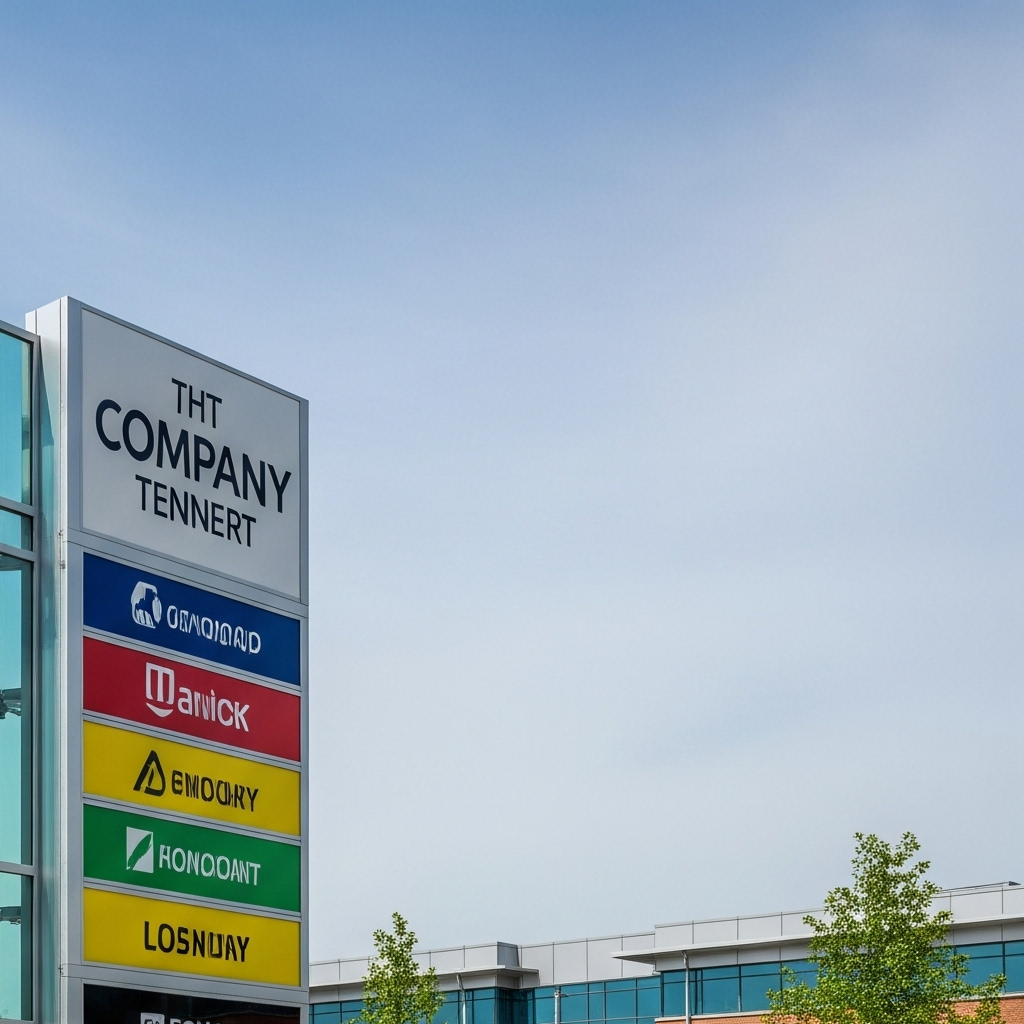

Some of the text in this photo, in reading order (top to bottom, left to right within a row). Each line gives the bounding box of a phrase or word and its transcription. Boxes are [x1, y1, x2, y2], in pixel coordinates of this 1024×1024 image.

[171, 377, 223, 429] THT
[95, 398, 292, 514] COMPANY
[135, 474, 257, 548] TENNERT
